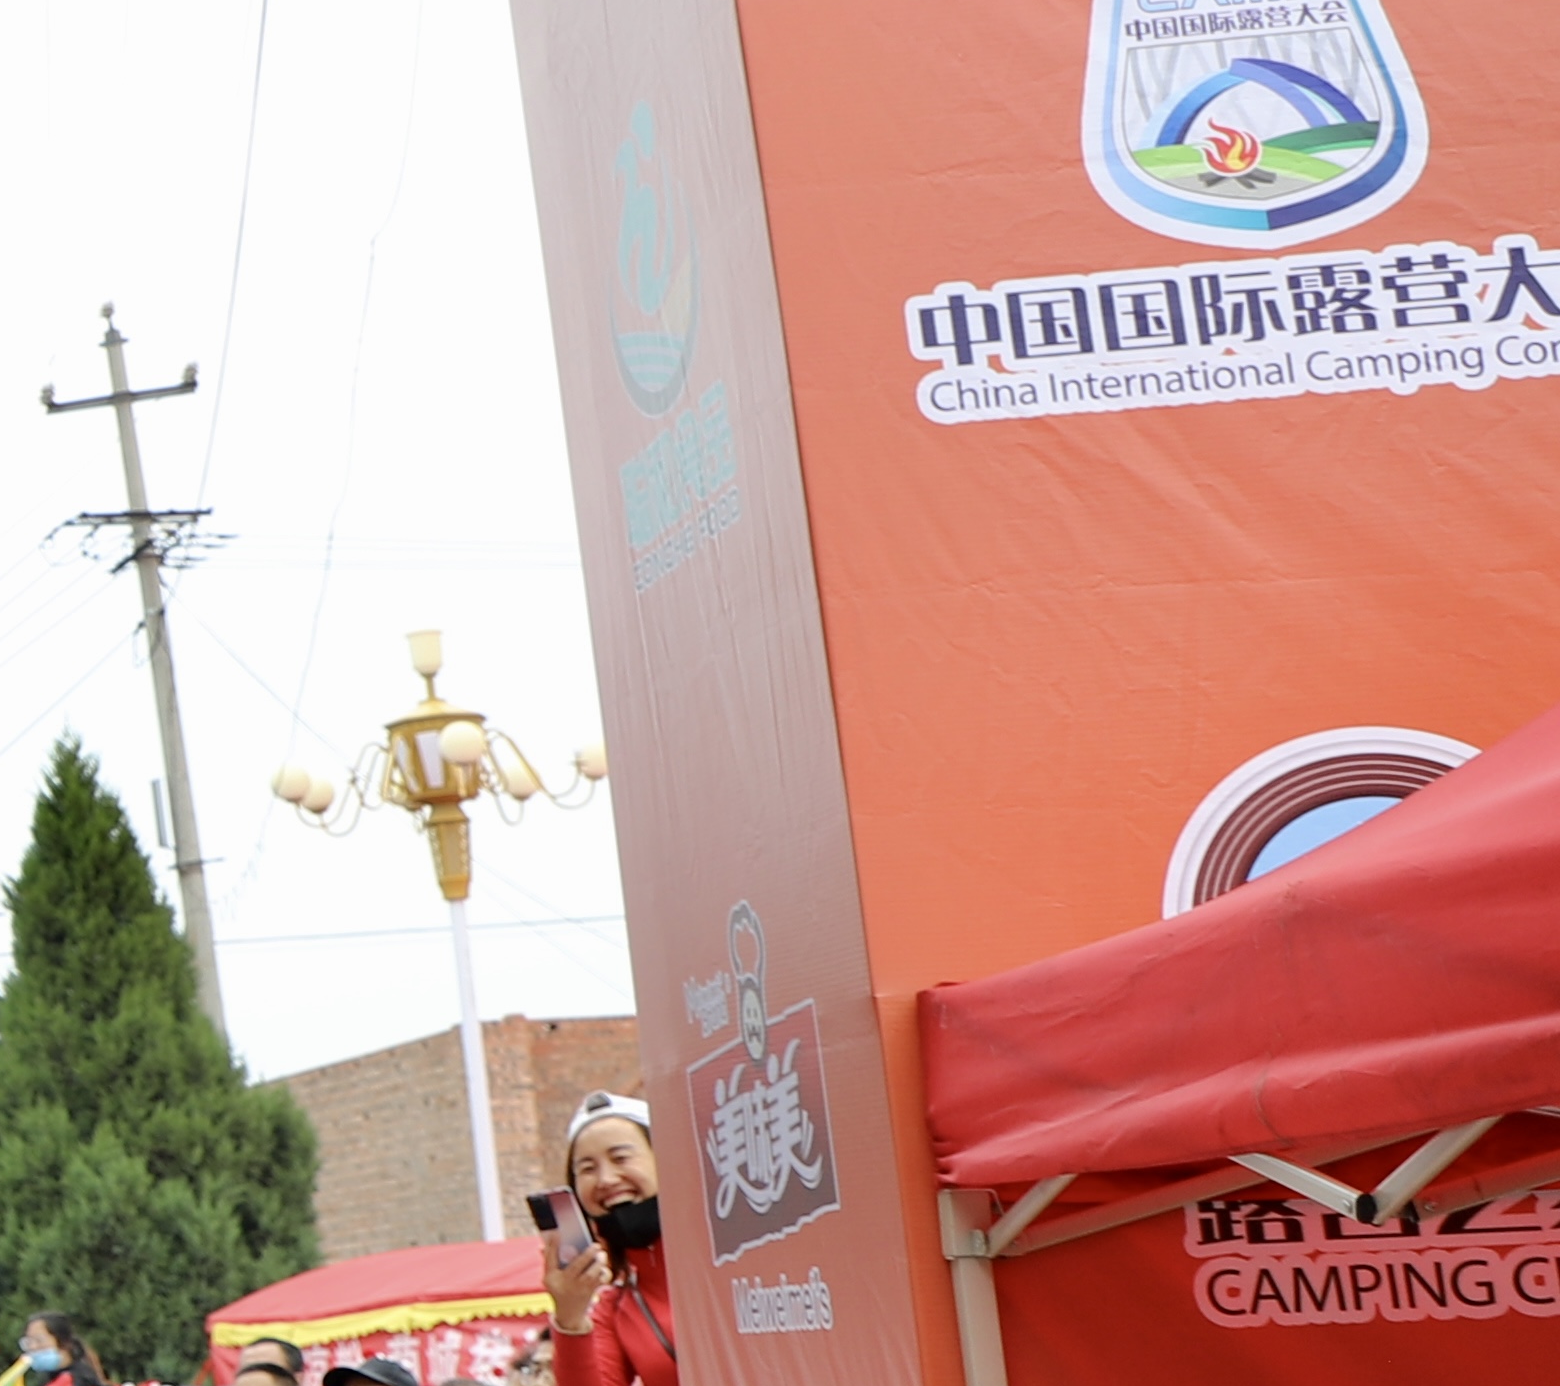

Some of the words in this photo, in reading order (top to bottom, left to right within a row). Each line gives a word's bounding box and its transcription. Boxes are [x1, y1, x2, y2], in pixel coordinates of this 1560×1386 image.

[1123, 0, 1350, 41] 中国国际露营大会
[918, 245, 1560, 368] 中国国际露营大
[928, 373, 1040, 414] China
[1049, 352, 1296, 404] International
[1305, 339, 1486, 384] Camping
[1206, 1259, 1497, 1316] CAMPING
[1513, 1256, 1560, 1305] C
